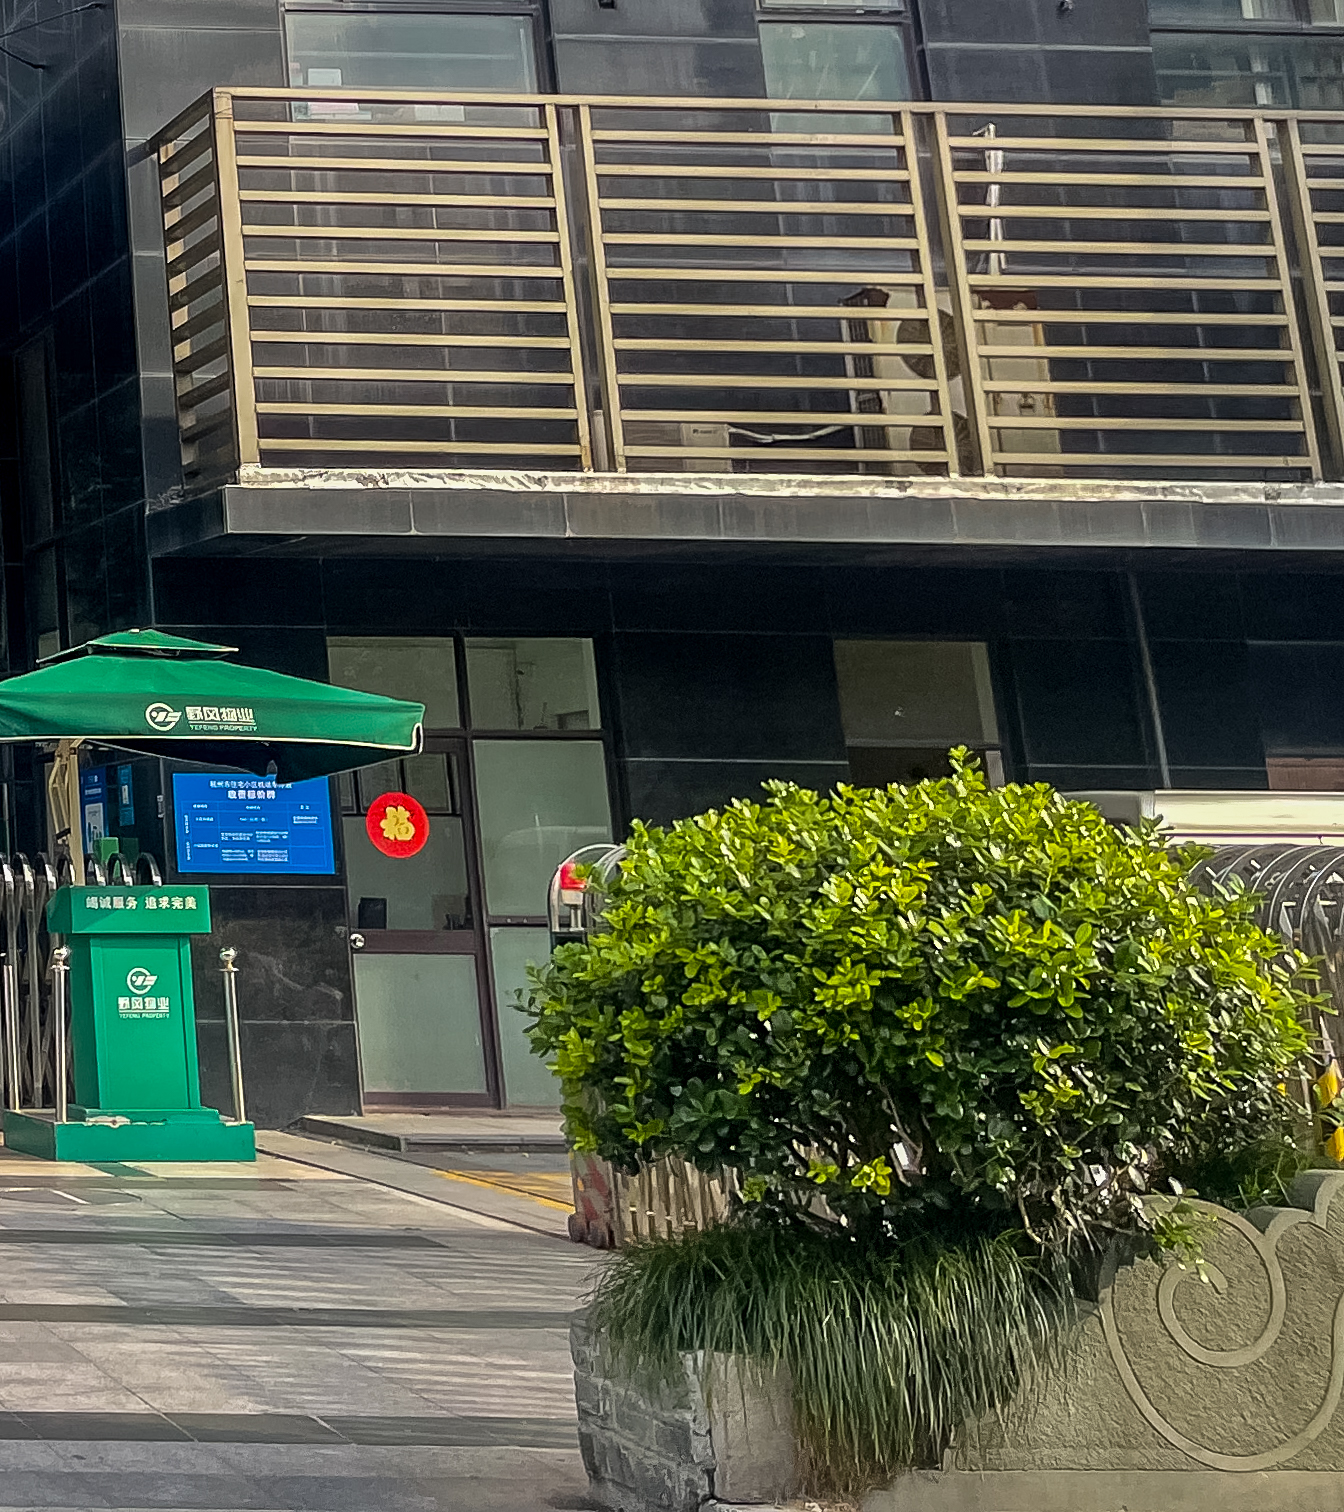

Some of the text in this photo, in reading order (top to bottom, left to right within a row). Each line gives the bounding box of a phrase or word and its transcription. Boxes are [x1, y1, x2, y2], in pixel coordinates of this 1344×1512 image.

[185, 707, 255, 722] 野风物业
[380, 805, 416, 841] 福
[145, 896, 197, 910] 追求完美
[118, 997, 170, 1010] 野风物业
